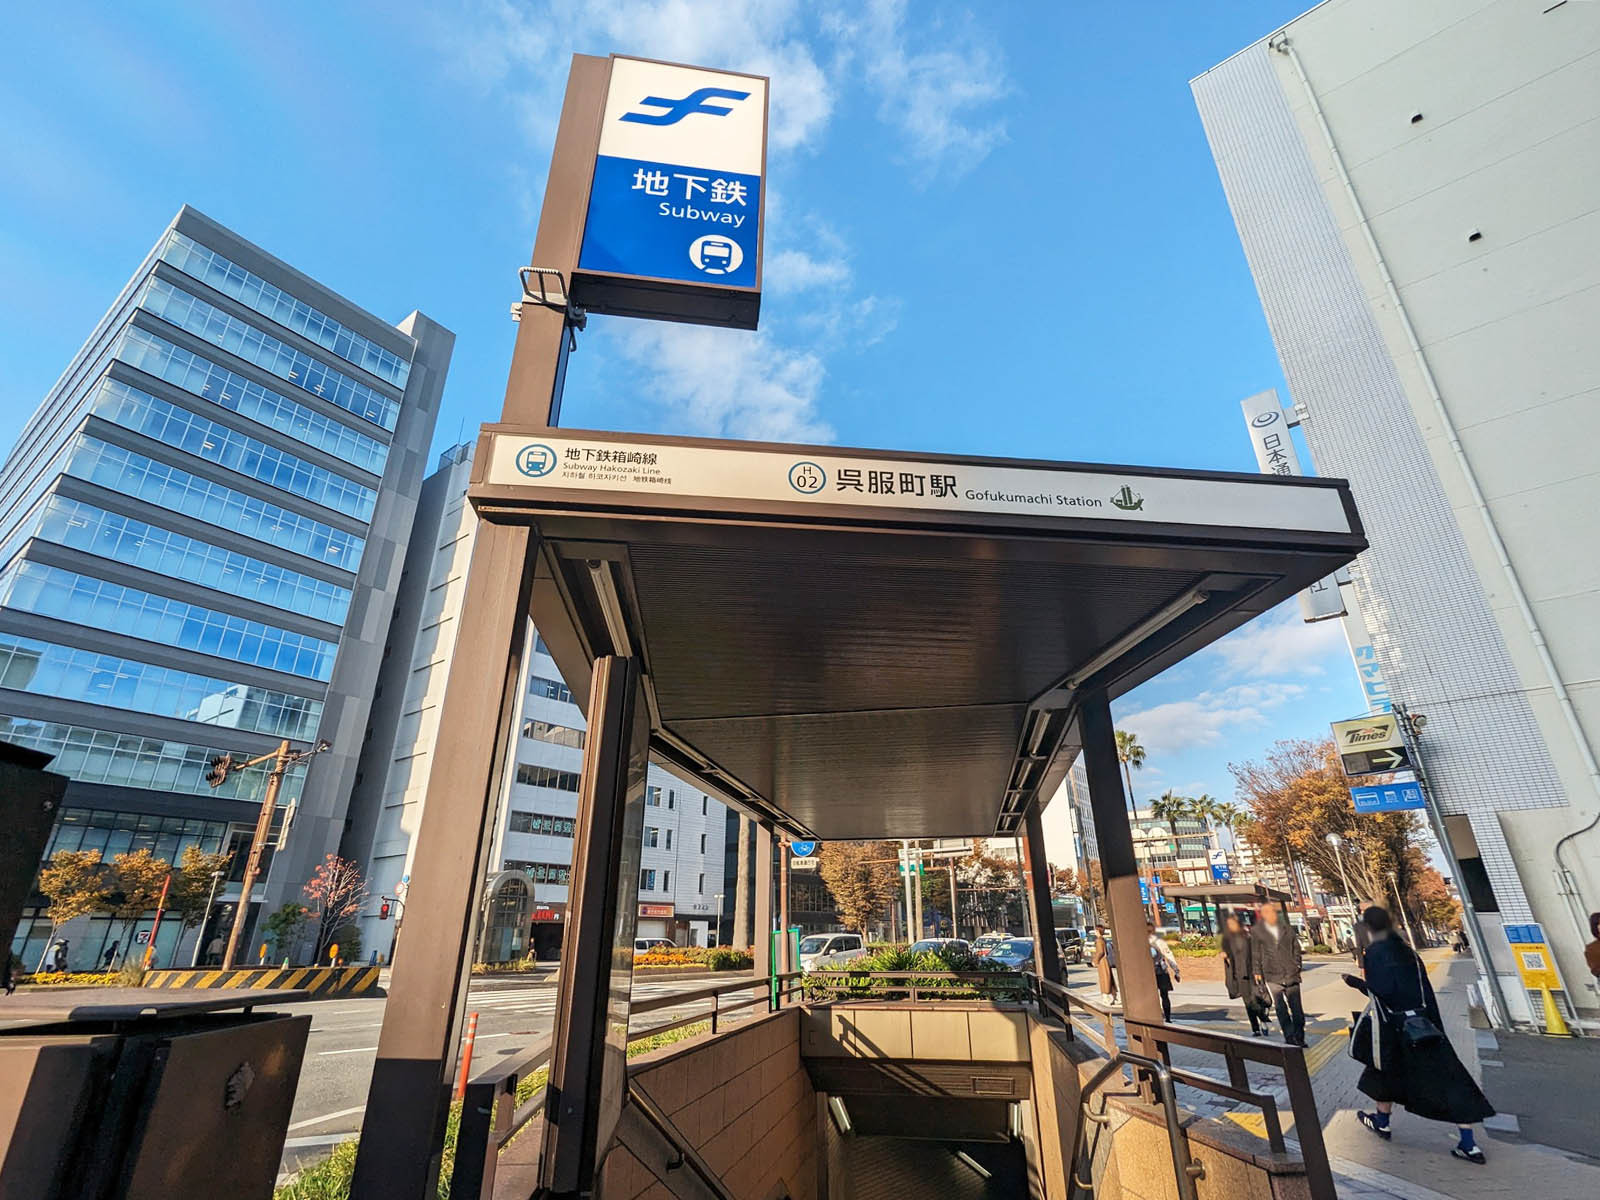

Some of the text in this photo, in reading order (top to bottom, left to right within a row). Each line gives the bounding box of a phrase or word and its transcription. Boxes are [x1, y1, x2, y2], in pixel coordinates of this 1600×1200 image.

[631, 168, 747, 207] 地下鉄
[659, 202, 746, 227] Subway
[564, 447, 658, 466] 地下鉄箱崎線
[562, 471, 586, 480] 지하철
[563, 462, 661, 475] Subway Hakozaki Line
[803, 466, 812, 475] H
[796, 475, 818, 489] 02
[836, 468, 958, 498] 呉服町駅
[965, 489, 1103, 508] Gofukumachi Station
[1345, 724, 1389, 743] Times
